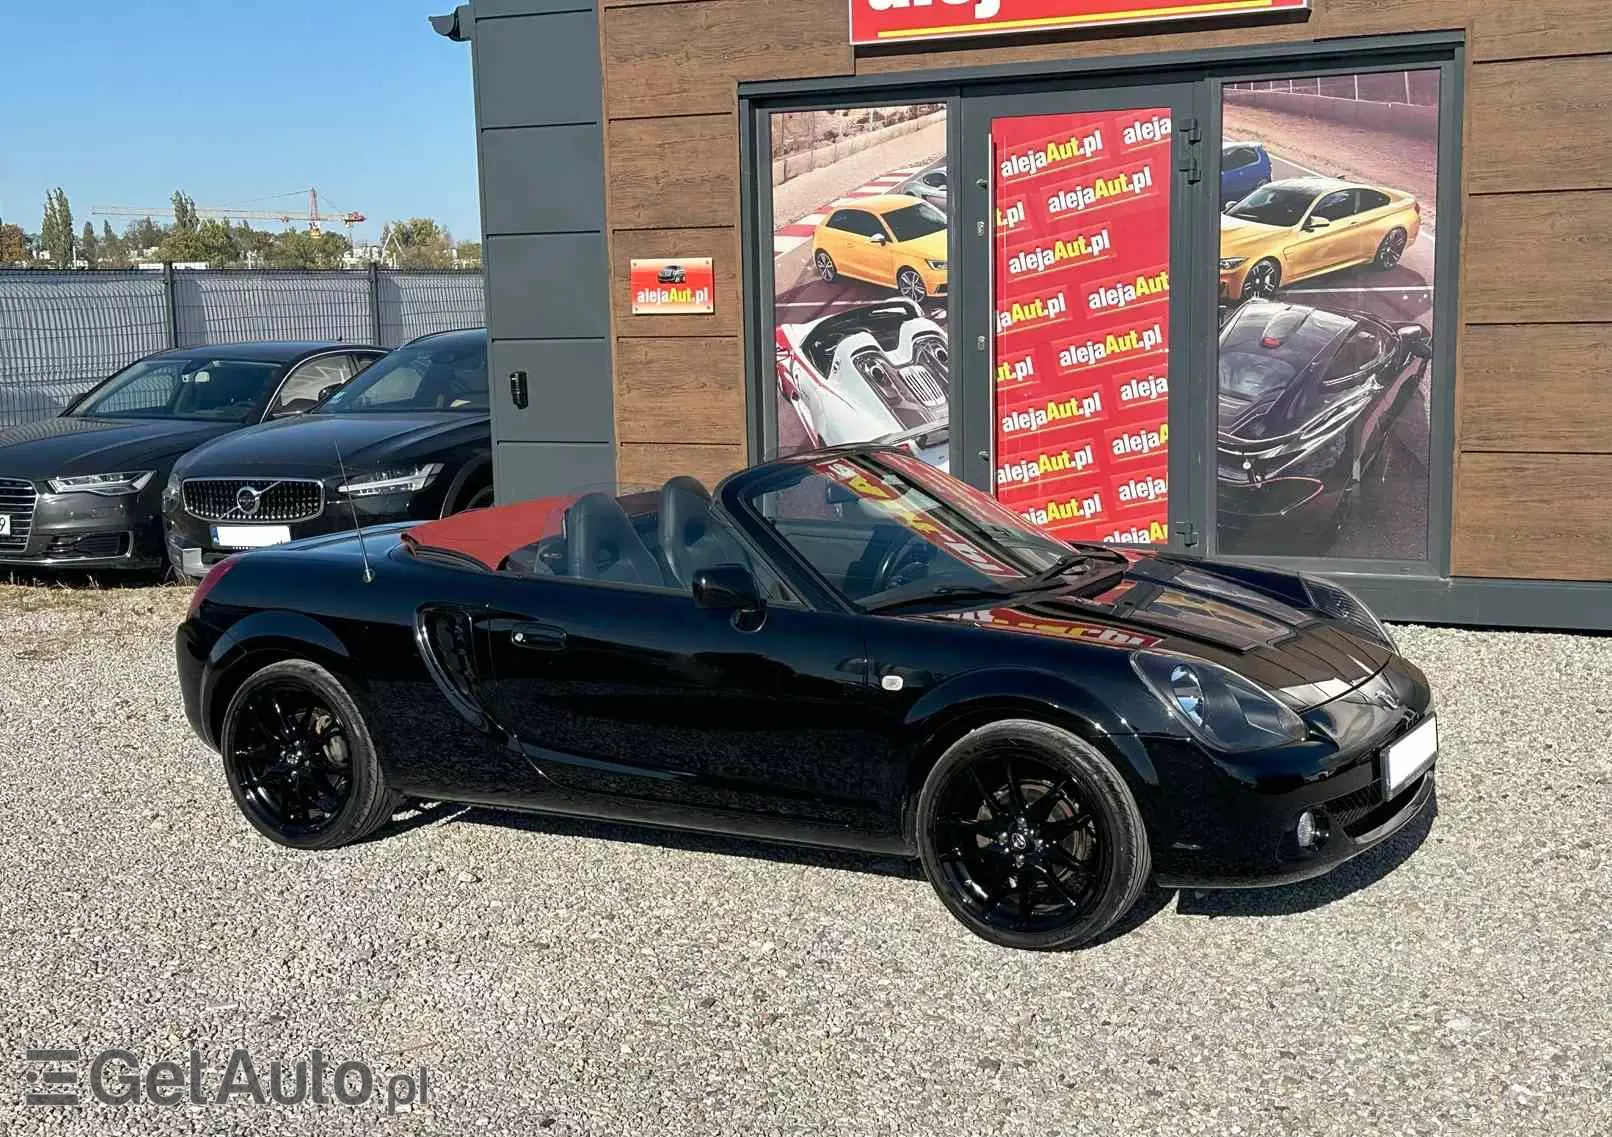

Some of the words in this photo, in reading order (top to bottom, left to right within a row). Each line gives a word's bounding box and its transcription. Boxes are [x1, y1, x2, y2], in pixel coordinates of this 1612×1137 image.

[1001, 130, 1103, 177] alejaAut.pl
[1048, 165, 1152, 213] alejaAut.pl
[1009, 229, 1111, 273] alejaAut.pl
[637, 287, 709, 304] alejaAut.pl
[1059, 324, 1162, 366] alejaAut.pl
[1002, 392, 1102, 433] alejaAut.pl
[997, 445, 1094, 484] alejaAut.pl
[1119, 476, 1168, 501] aleja
